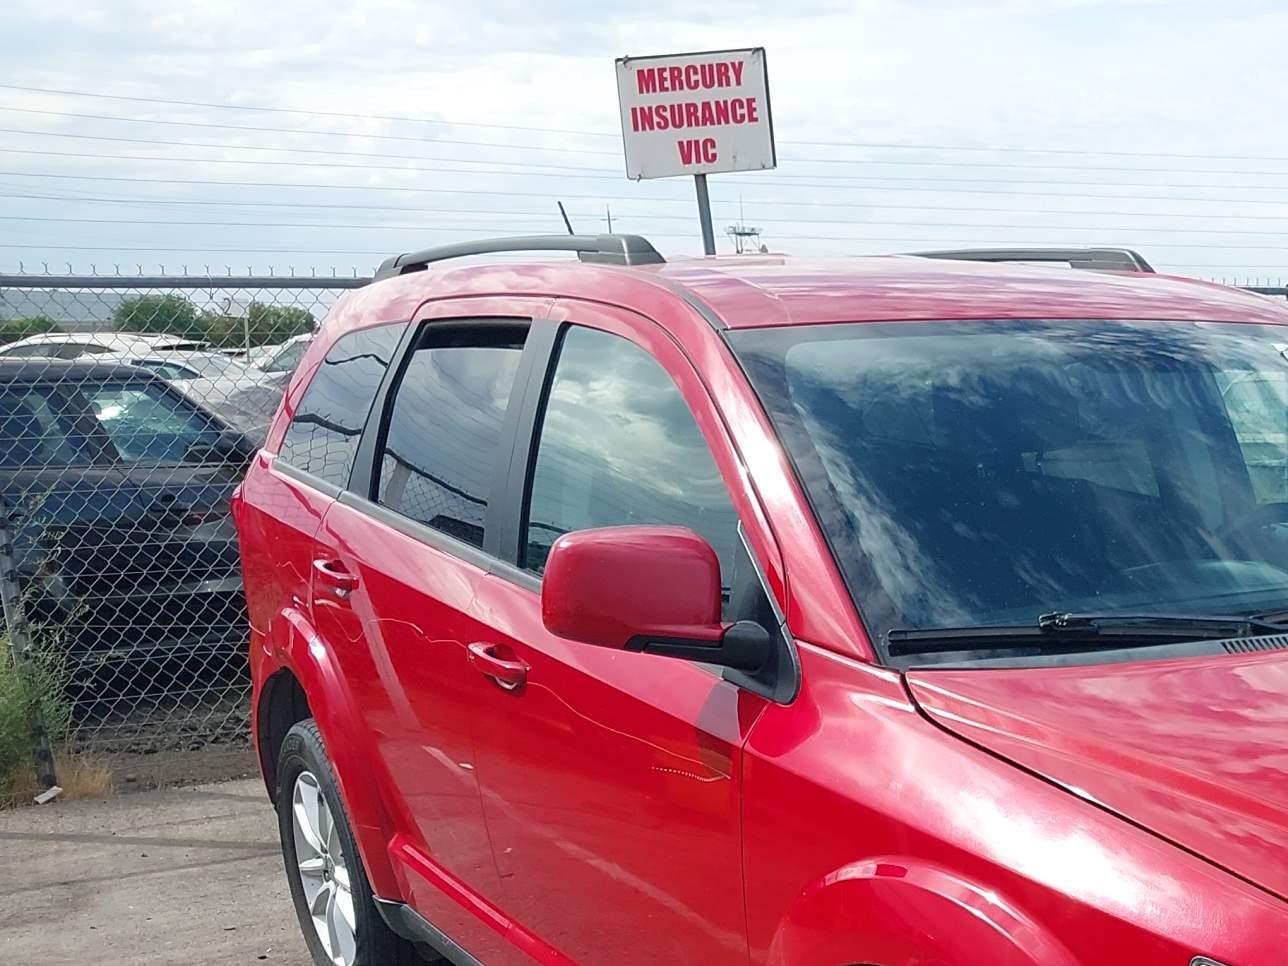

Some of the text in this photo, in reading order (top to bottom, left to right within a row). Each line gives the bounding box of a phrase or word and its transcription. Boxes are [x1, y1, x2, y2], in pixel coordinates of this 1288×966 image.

[637, 61, 744, 94] MERCURY
[631, 98, 759, 132] INSURANCE
[677, 138, 718, 165] VIC
